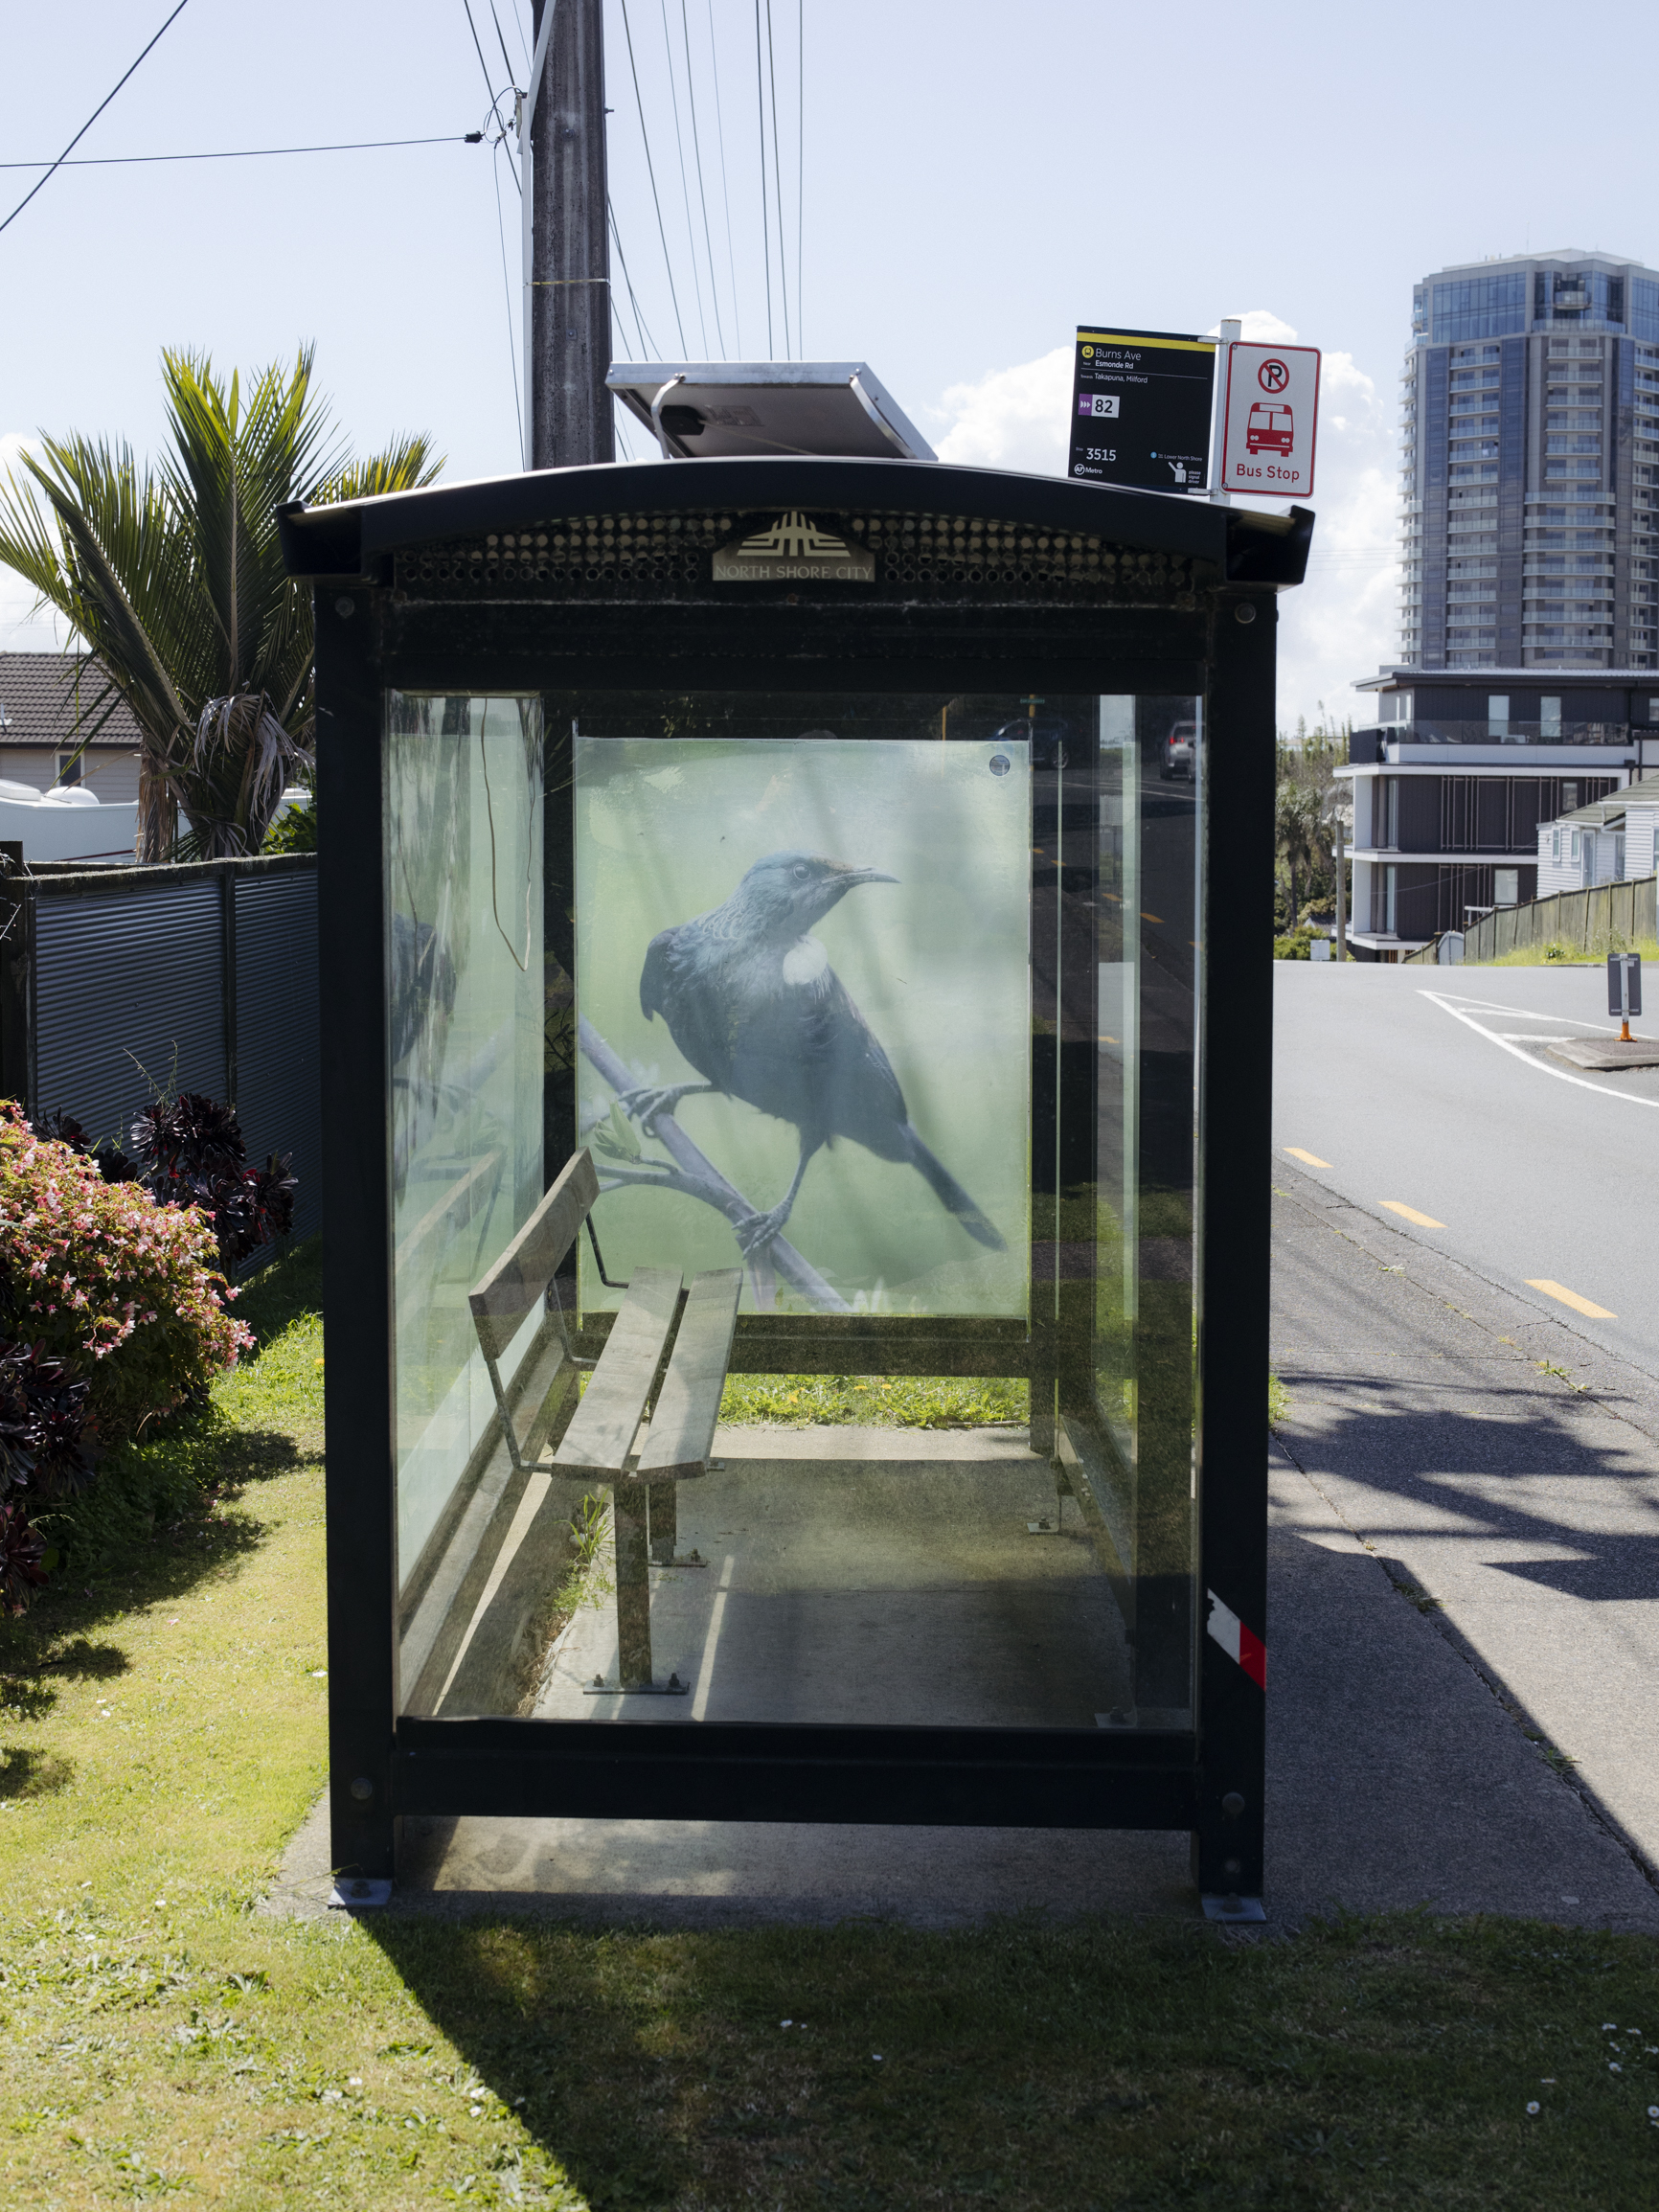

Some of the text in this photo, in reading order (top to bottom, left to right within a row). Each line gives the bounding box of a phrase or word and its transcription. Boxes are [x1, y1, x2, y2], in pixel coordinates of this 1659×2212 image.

[1095, 348, 1142, 360] Burns Ave
[1095, 373, 1148, 384] Takapuna, Milford
[1095, 399, 1113, 413] 82
[1086, 447, 1117, 462] 3515
[1236, 463, 1300, 483] Bus Stop
[716, 565, 872, 580] NORTH SHORE CITY
